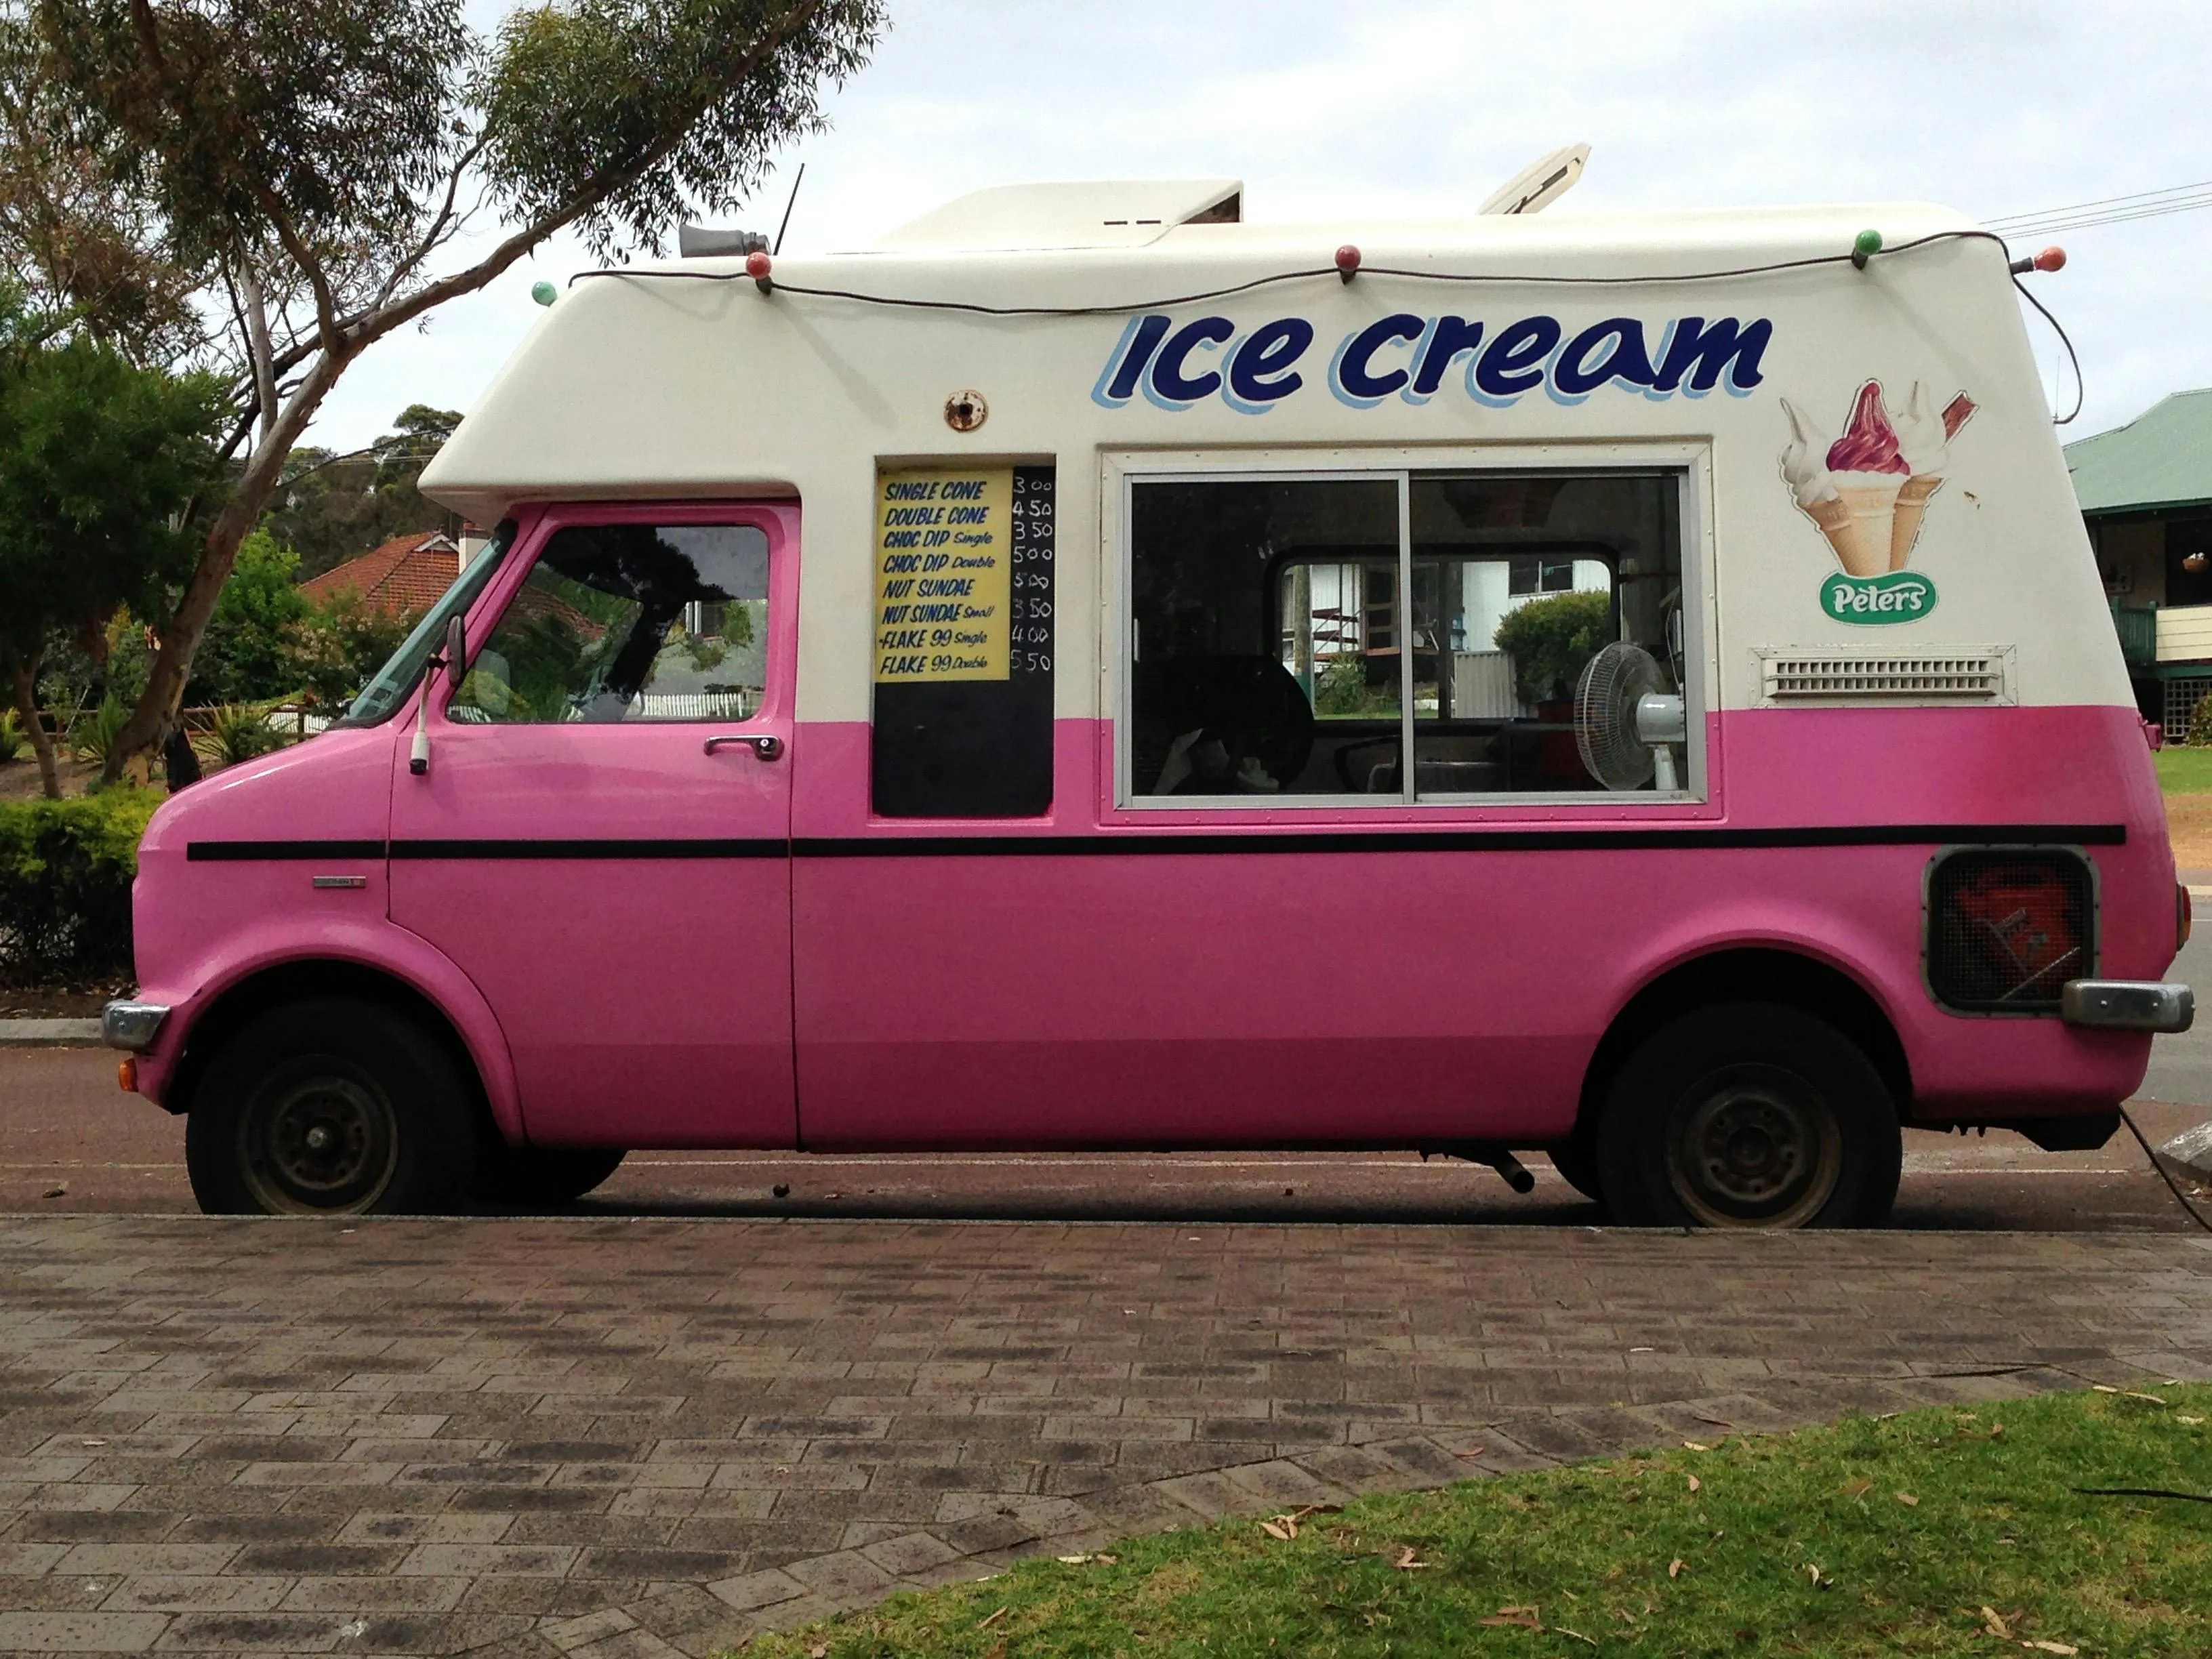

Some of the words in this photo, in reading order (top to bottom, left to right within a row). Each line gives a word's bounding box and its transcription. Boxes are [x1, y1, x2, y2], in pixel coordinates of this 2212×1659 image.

[1092, 314, 1315, 414] Ice
[1328, 313, 1774, 409] cream
[884, 482, 939, 501] SINGLE
[941, 481, 987, 500] CONE
[884, 507, 946, 526] DOUBLE
[947, 506, 989, 525] CONE
[883, 531, 922, 548] CHOC
[923, 530, 950, 548] DIP
[953, 531, 994, 548] Single
[883, 555, 922, 573] CHOC
[923, 554, 949, 572] DIP
[951, 556, 996, 569] Double
[882, 579, 916, 598] NUT
[916, 579, 976, 597] SUNDAE
[1831, 582, 1928, 614] Peters
[882, 605, 912, 624] NUT
[909, 604, 964, 623] SUNDAE
[963, 606, 995, 619] Small
[880, 630, 928, 649] FLAKE
[930, 629, 952, 647] 99
[954, 631, 987, 648] Single
[880, 655, 928, 674] FLAKE
[930, 655, 952, 672] 99
[951, 656, 988, 671] Double
